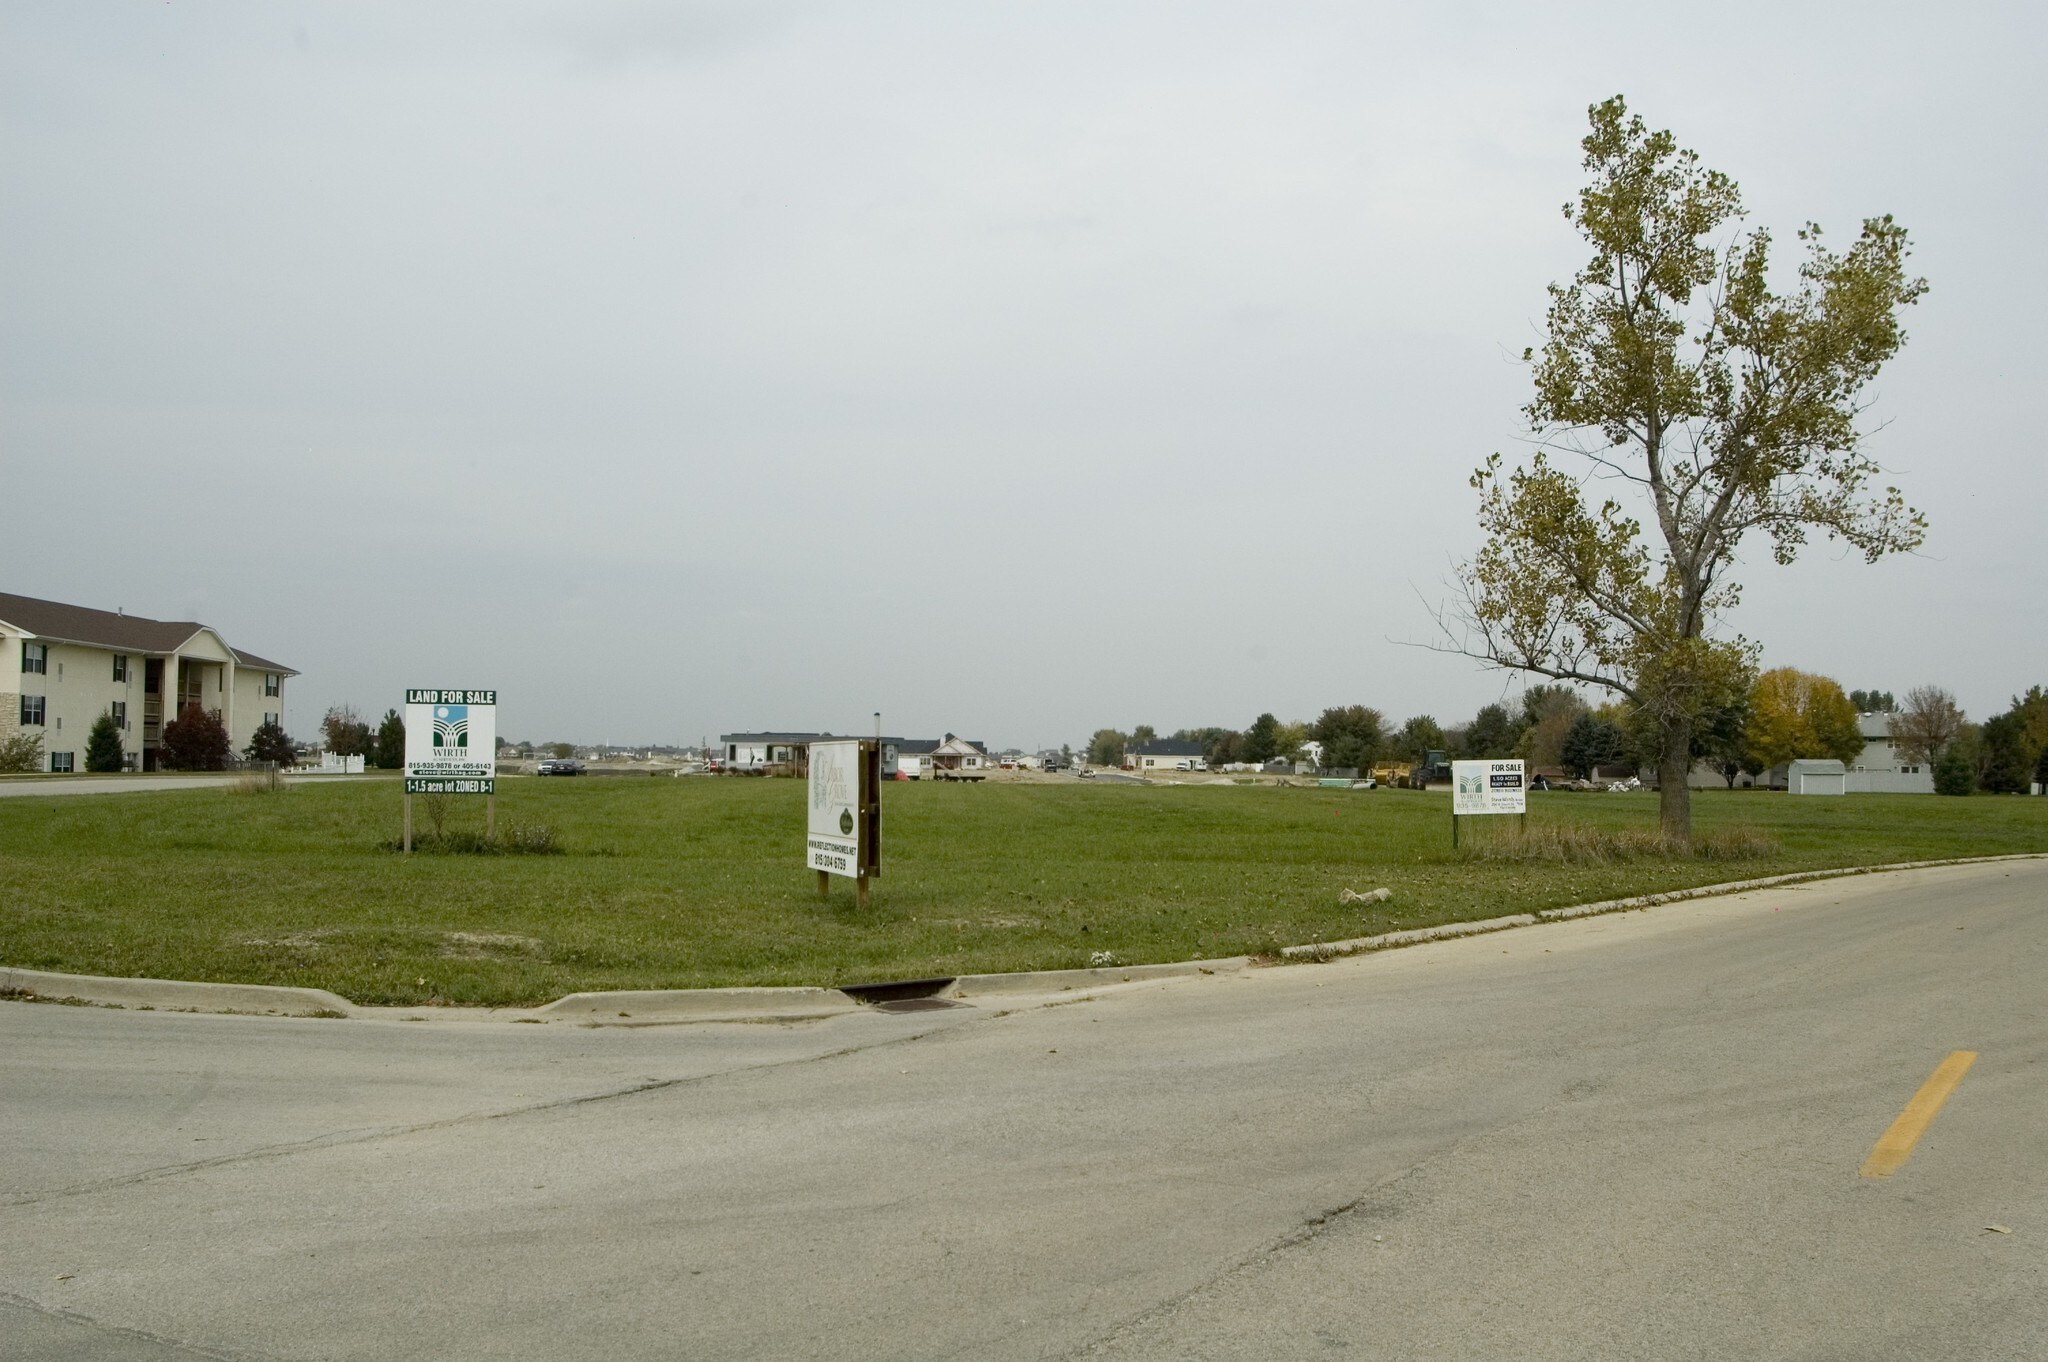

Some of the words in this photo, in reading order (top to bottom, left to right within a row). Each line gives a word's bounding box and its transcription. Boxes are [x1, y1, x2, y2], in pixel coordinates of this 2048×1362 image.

[409, 690, 438, 703] LAND
[441, 690, 464, 703] FOR
[466, 691, 494, 704] SALE
[433, 748, 468, 757] WIRTH
[1491, 764, 1505, 772] FOR
[1505, 763, 1522, 772] SALE
[407, 780, 426, 792] 1-1.5
[427, 782, 443, 792] acre
[444, 780, 455, 792] lot
[456, 780, 479, 793] ZONED
[480, 781, 493, 793] B-1
